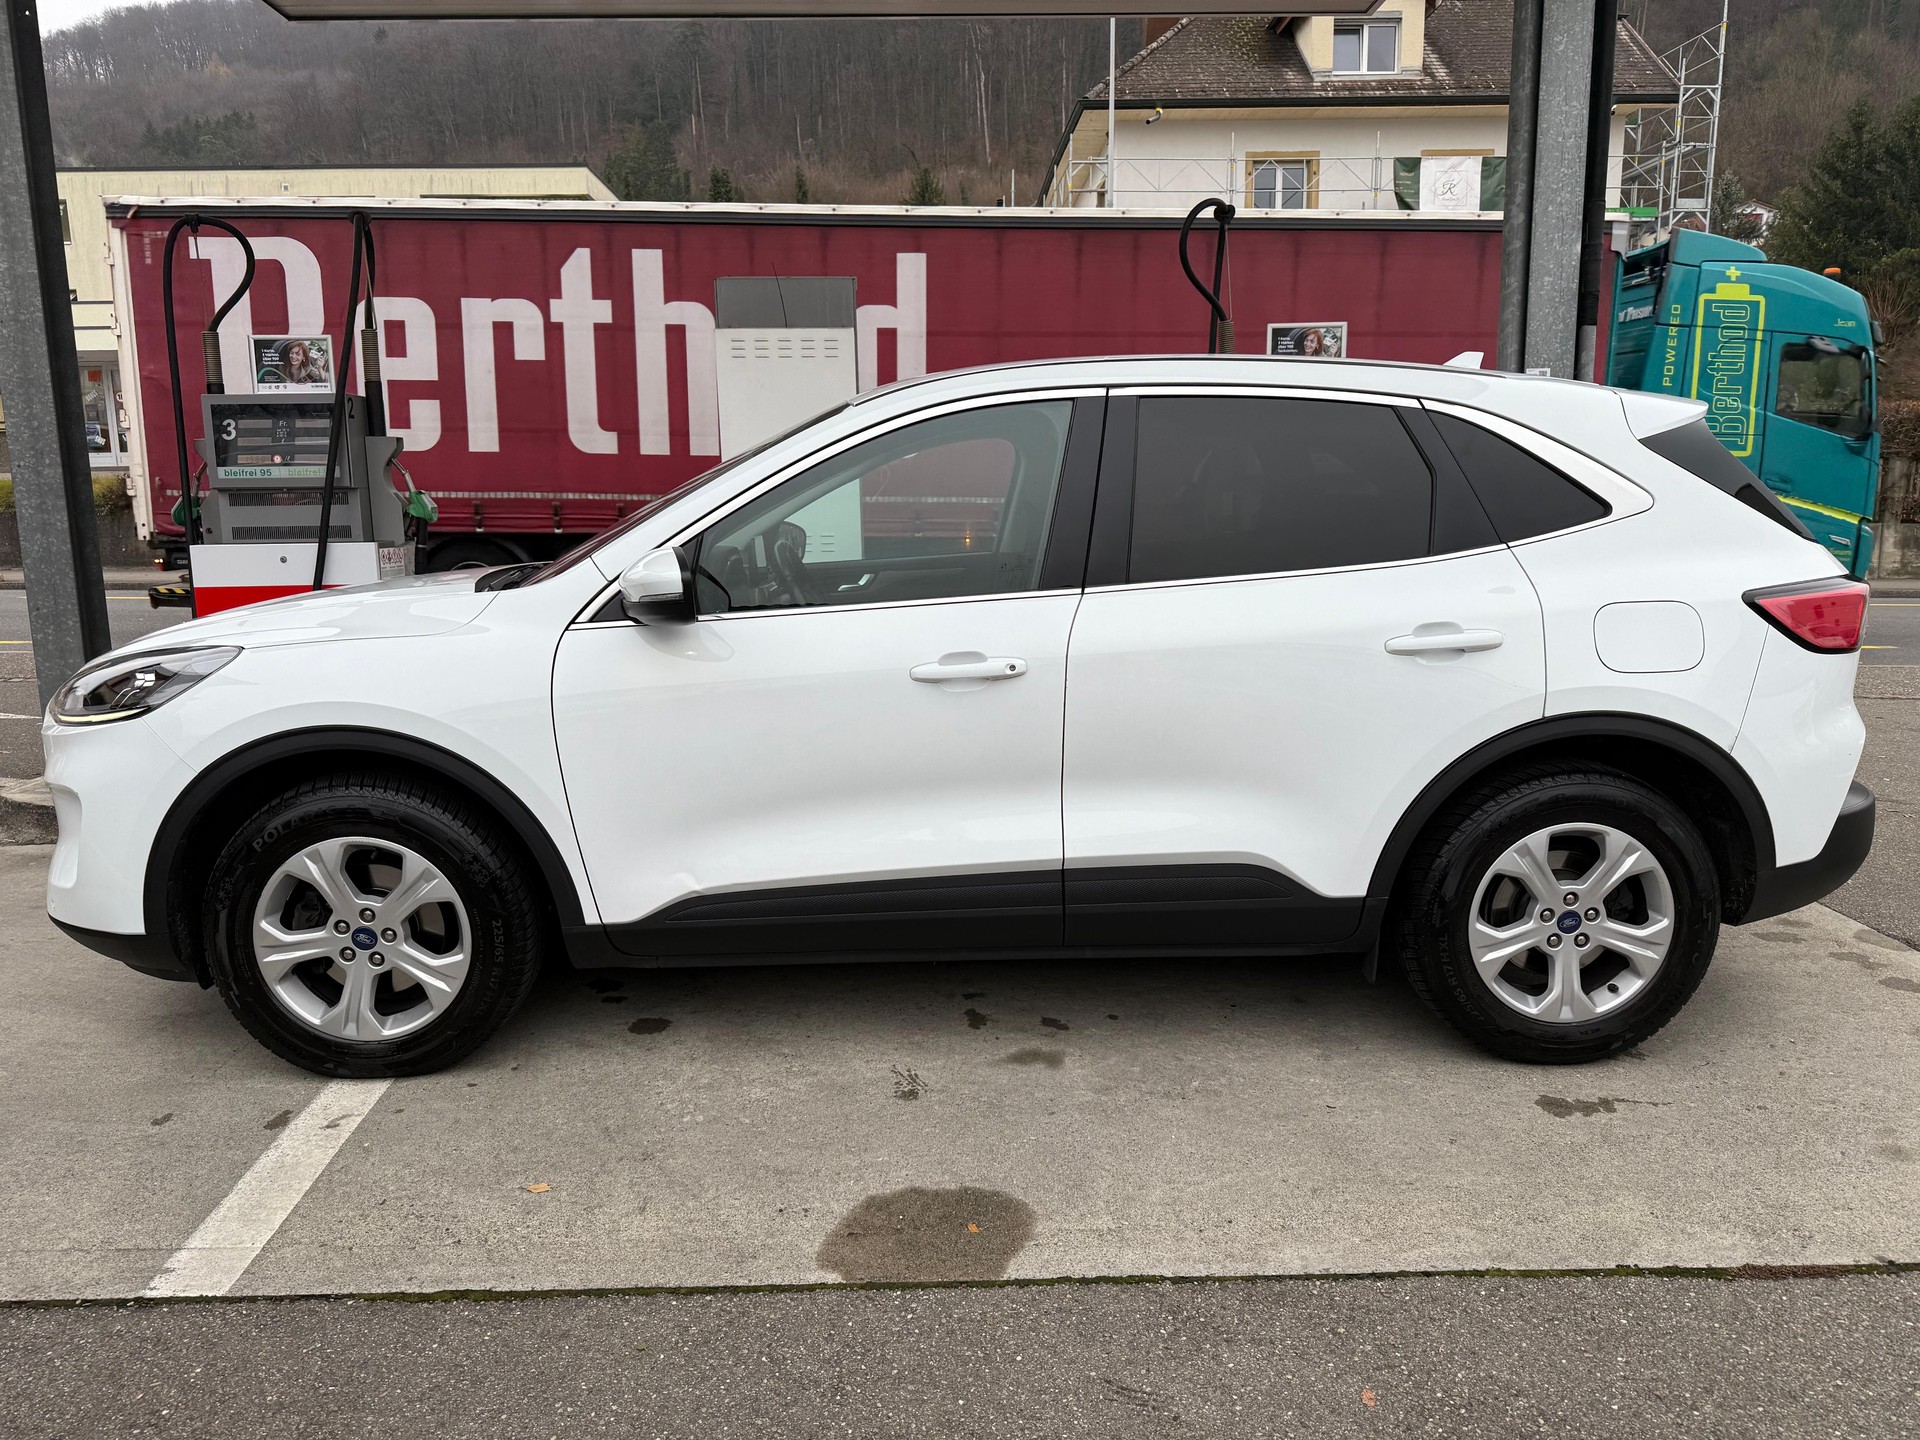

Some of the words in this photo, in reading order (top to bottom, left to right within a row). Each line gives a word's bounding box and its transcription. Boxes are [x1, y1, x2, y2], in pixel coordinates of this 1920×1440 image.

[189, 235, 926, 457] Berthd
[1662, 304, 1681, 387] POWERED
[1705, 303, 1751, 445] Berthod
[347, 397, 355, 419] 2
[221, 418, 237, 441] 3
[224, 468, 257, 477] bleifrei
[259, 468, 272, 477] 95
[288, 467, 321, 477] bleifrei
